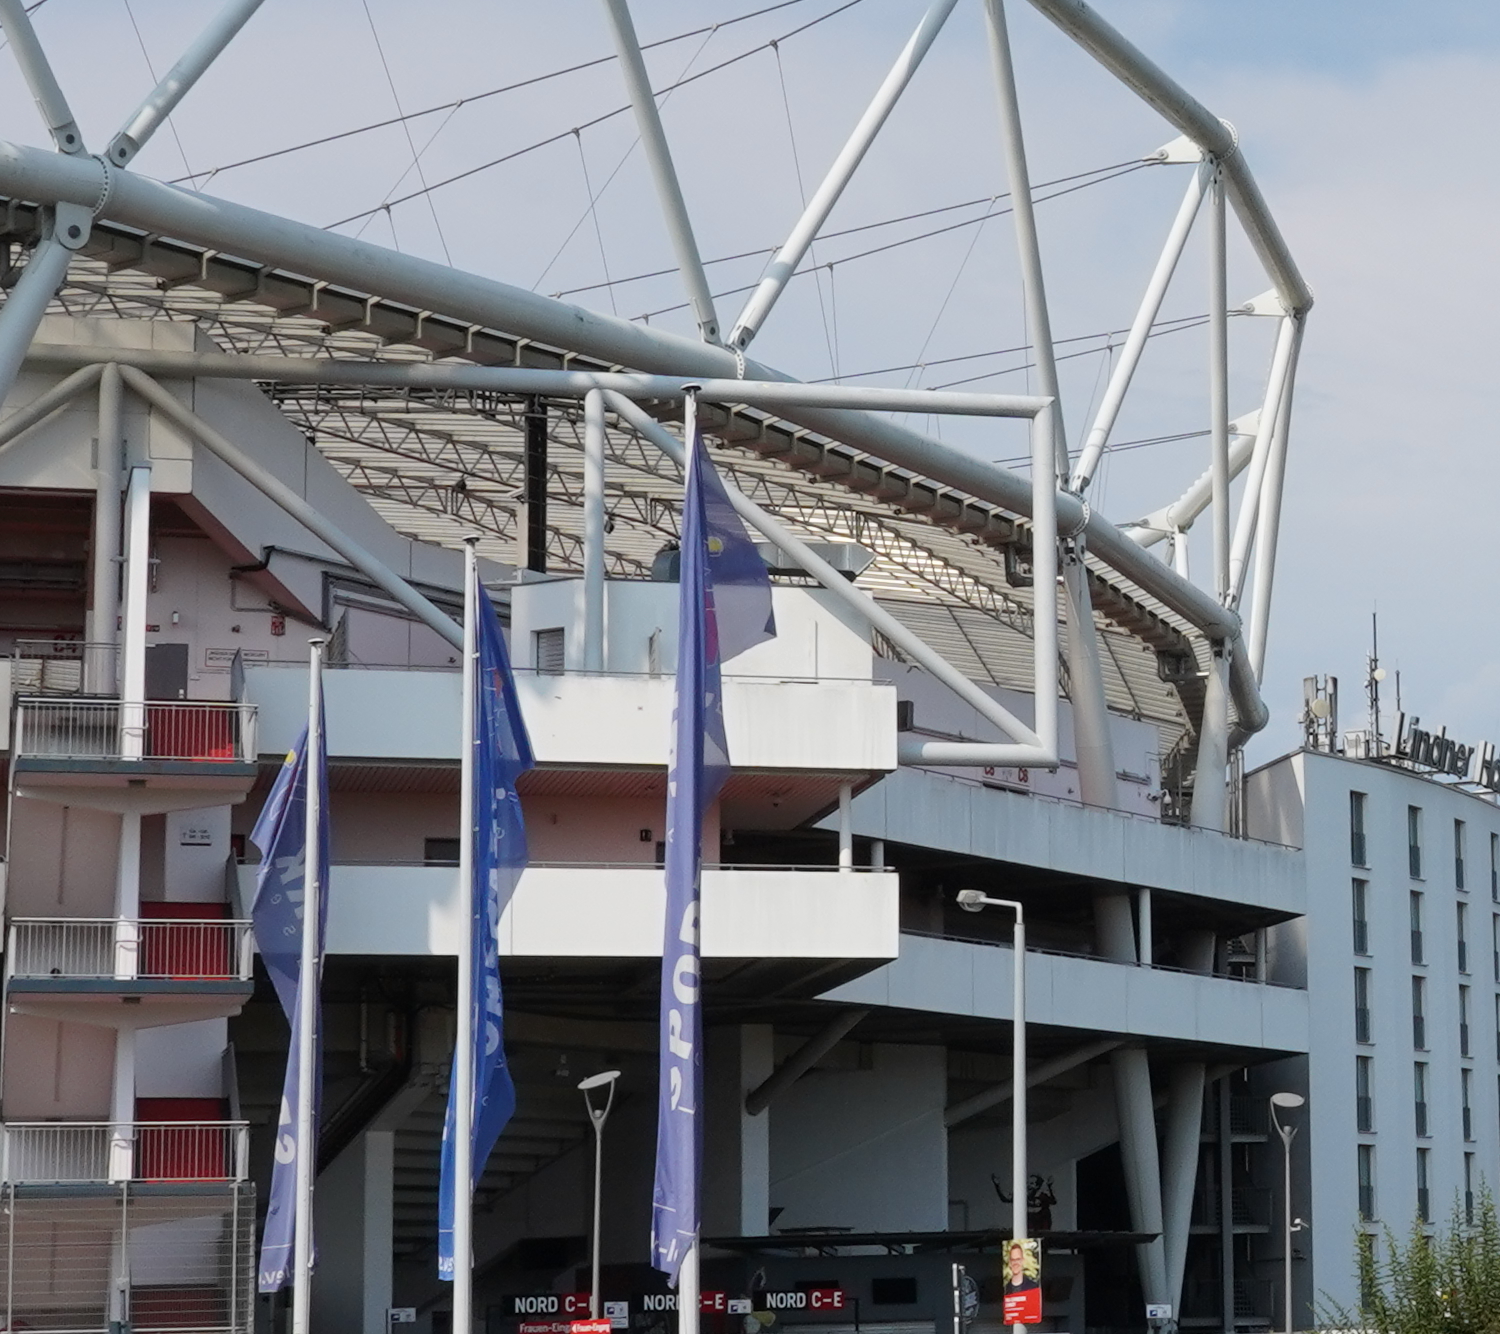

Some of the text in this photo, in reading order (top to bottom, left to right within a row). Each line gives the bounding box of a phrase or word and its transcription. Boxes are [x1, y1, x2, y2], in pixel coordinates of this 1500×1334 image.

[515, 1296, 558, 1313] NORD
[766, 1291, 842, 1308] NORD C-E
[519, 1323, 571, 1334] Frauen-Eing
